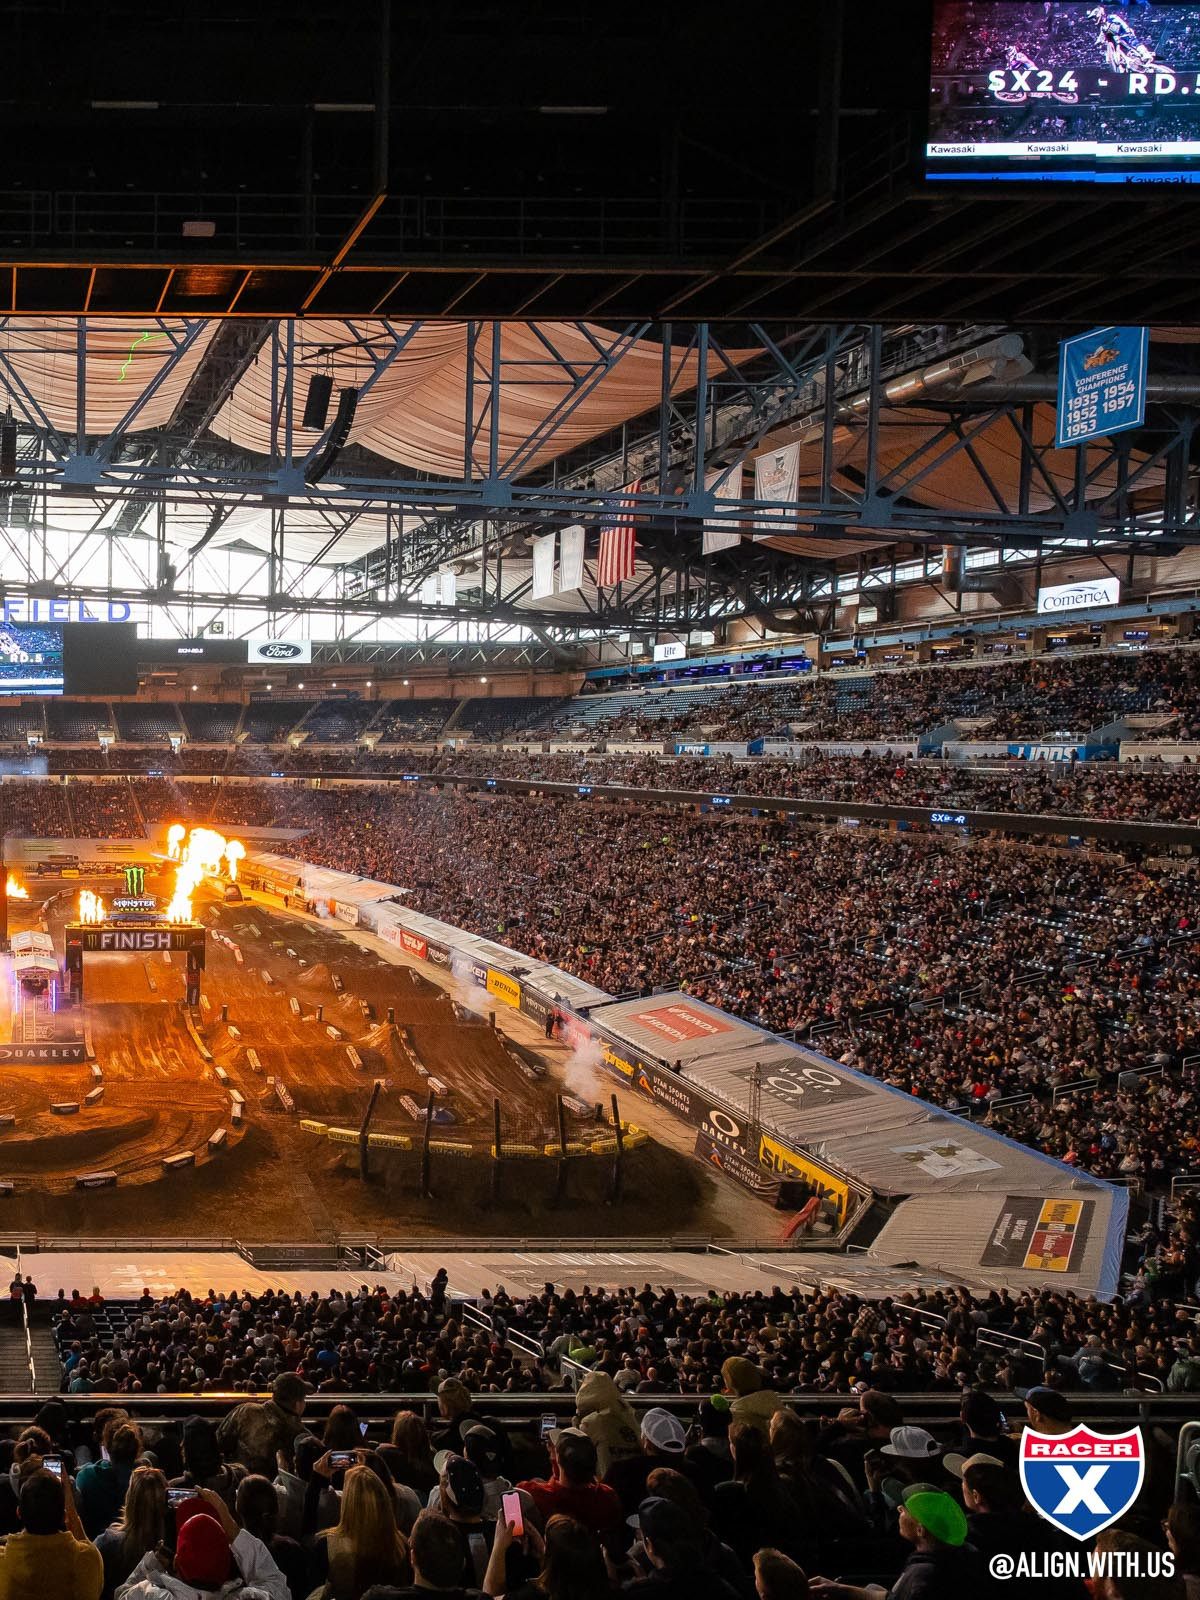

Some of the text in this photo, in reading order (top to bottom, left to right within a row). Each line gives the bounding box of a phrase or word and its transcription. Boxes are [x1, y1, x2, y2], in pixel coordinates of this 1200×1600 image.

[988, 70, 1078, 92] SX24
[931, 144, 1162, 154] Kawasaki Kawasaki Kawasaki
[1075, 363, 1129, 387] CONFERENCE
[1077, 372, 1126, 394] CHAMPIONS
[1103, 380, 1135, 400] 1954
[1067, 391, 1098, 411] 1935
[1102, 394, 1135, 414] 1957
[1067, 405, 1097, 424] 1952
[1066, 419, 1097, 438] 1953
[3, 599, 131, 622] FIELD
[10, 653, 44, 663] RD.5
[266, 644, 294, 657] Ford
[663, 646, 677, 658] Lite
[113, 899, 156, 908] MONSTER
[100, 932, 172, 949] FINISH
[494, 978, 519, 998] DUNLOP
[650, 1017, 688, 1041] HONDA
[678, 1011, 719, 1034] HONDA
[14, 1049, 81, 1058] OAKLEY
[653, 1075, 690, 1105] UTAH SPORTS
[653, 1085, 690, 1114] COMMISSION
[701, 1121, 747, 1156] OAKLEY
[723, 1161, 760, 1189] COMMISSION
[724, 1154, 762, 1182] UTAH SPORTS
